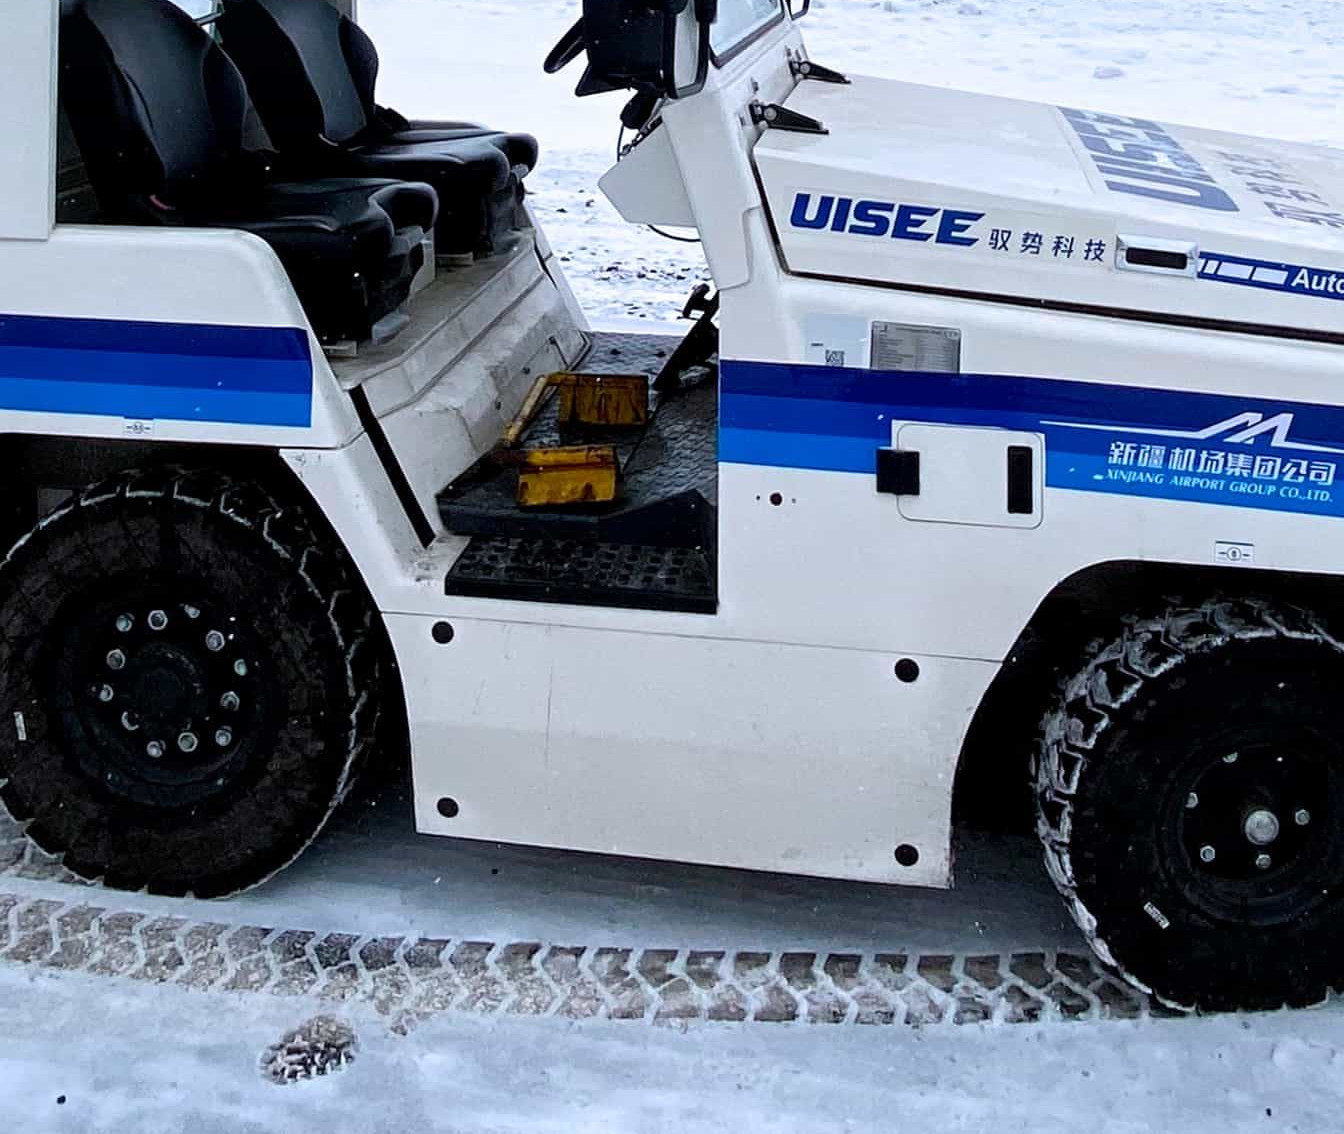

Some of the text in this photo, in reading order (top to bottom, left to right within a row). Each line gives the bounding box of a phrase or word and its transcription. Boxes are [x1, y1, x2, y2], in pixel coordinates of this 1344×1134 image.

[791, 193, 986, 246] UISEE
[988, 228, 1106, 263] 驭势科技
[1106, 468, 1165, 485] XINJIANG
[1169, 475, 1226, 492] AIRPORT
[1229, 481, 1276, 497] GROUP
[1108, 441, 1337, 486] 新疆机场集团公司
